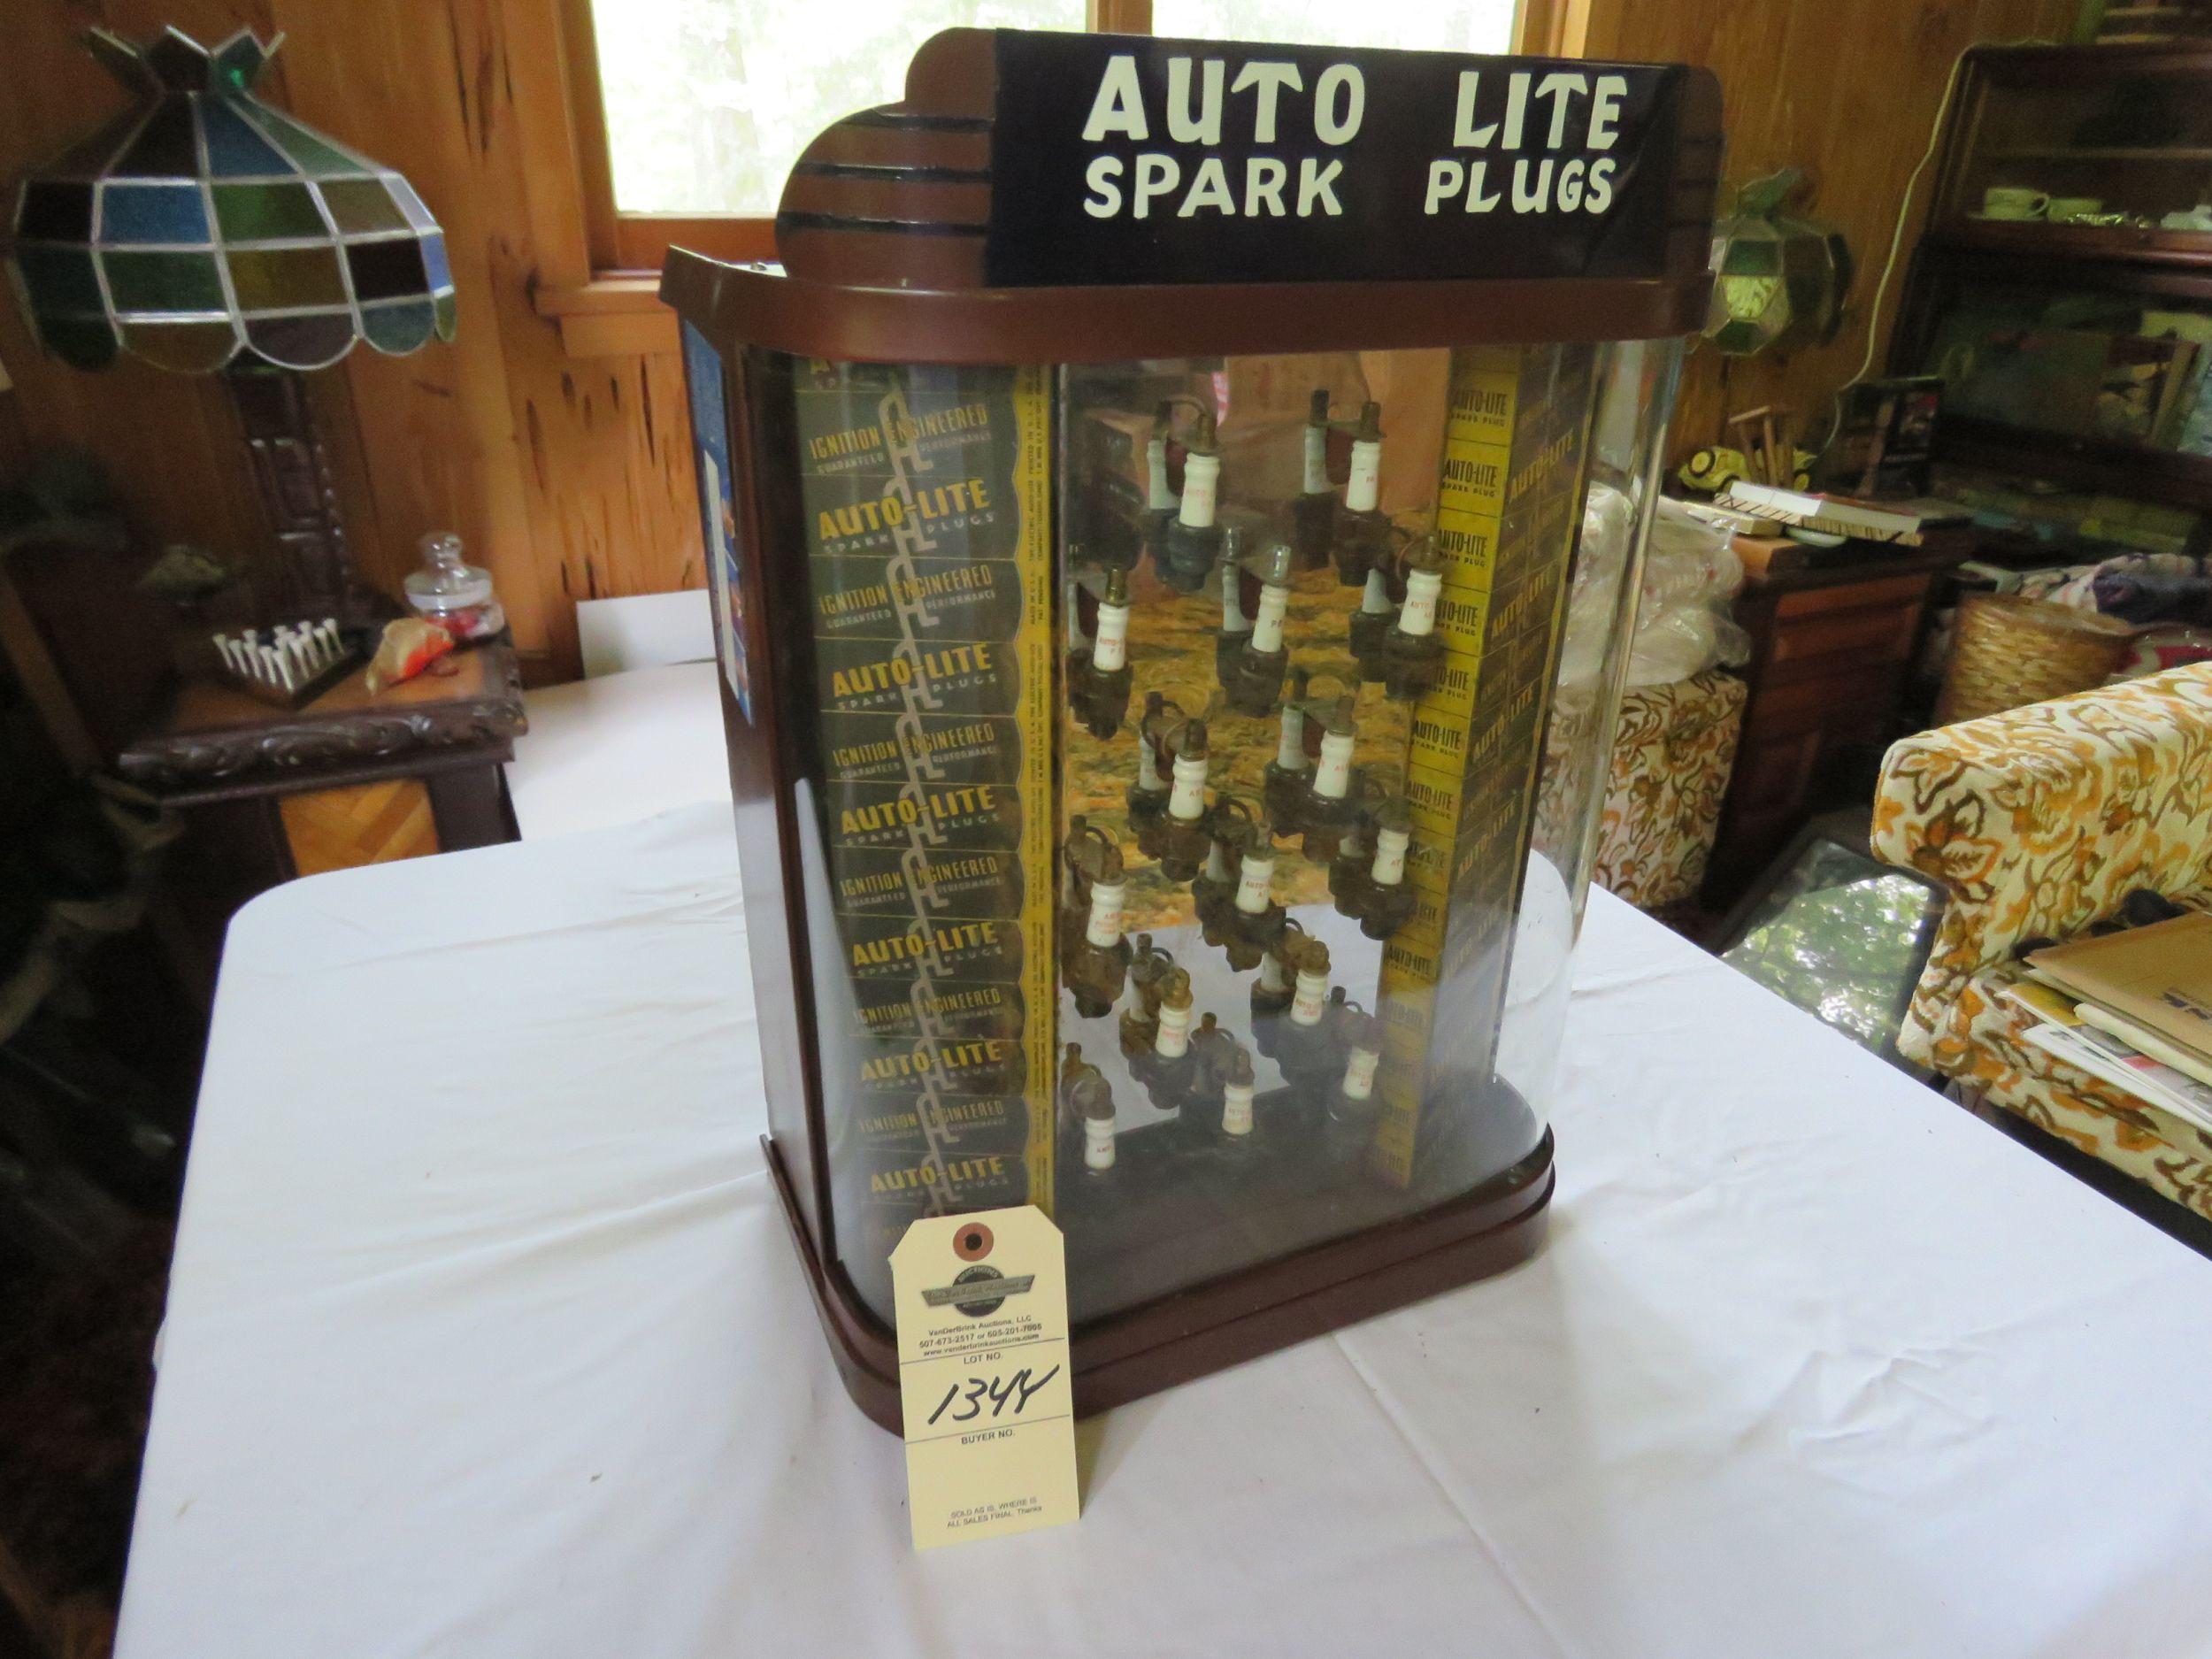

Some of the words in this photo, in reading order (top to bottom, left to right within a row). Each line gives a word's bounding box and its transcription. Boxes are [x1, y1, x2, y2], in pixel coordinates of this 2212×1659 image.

[1081, 55, 1365, 146] AUTO
[1453, 70, 1628, 150] LITE
[1083, 155, 1344, 219] SPARK
[1424, 157, 1616, 214] PLUGS
[1444, 458, 1499, 488] AUTO-LITE
[819, 479, 991, 541] AUTO-LITE
[818, 584, 888, 615] IGNITION
[833, 641, 992, 697] AUTO-LITE
[933, 673, 996, 693] PLUGS
[833, 740, 897, 767] IGNITION
[902, 723, 995, 757] ENGINEERED
[1416, 719, 1462, 750] AUTO-LITE
[841, 784, 996, 835] AUTO-LITE
[938, 813, 1000, 831] PLUGS
[841, 872, 902, 896] IGNITION
[852, 921, 999, 967] AUTO-LITE
[861, 1040, 1002, 1082] AUTO-LITE
[871, 1156, 1004, 1194] AUTO-LITE
[1016, 1315, 1032, 1324] LLC
[963, 1353, 982, 1364] LOT
[961, 1432, 996, 1446] BUYER
[997, 1428, 1017, 1440] NO.
